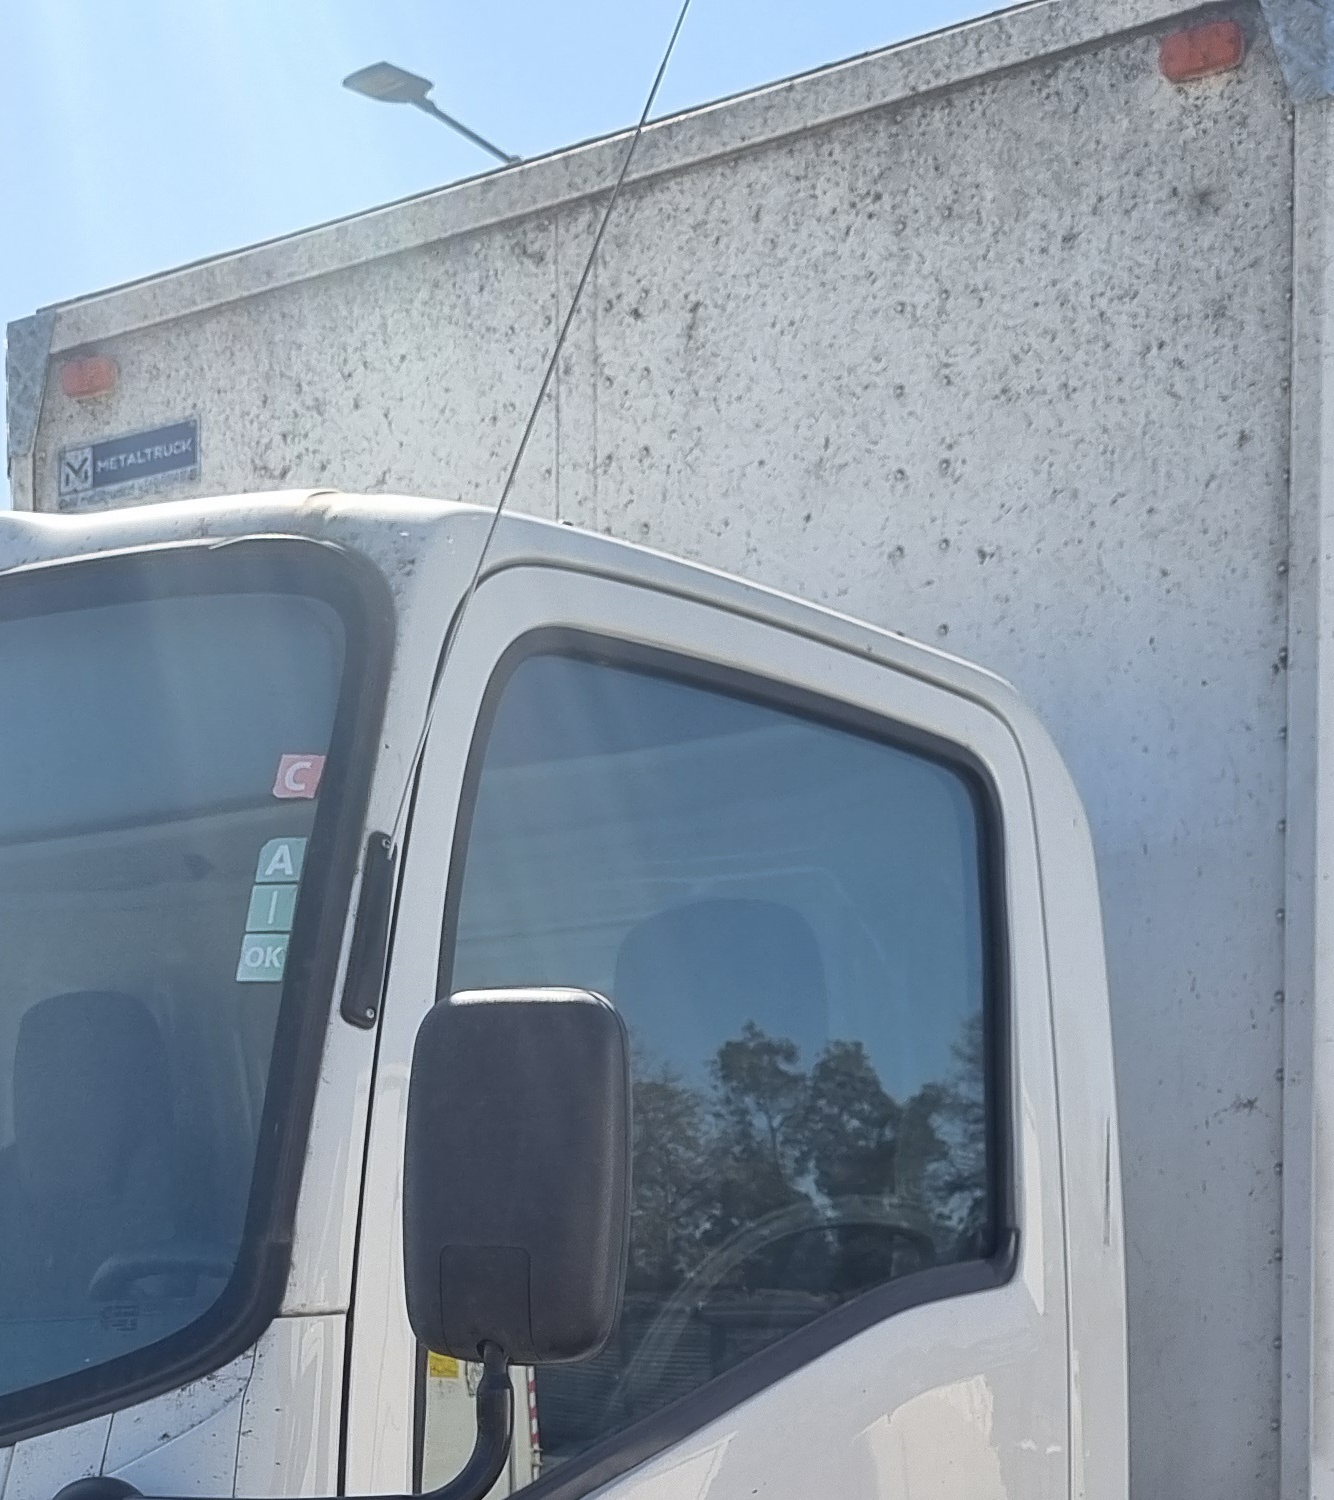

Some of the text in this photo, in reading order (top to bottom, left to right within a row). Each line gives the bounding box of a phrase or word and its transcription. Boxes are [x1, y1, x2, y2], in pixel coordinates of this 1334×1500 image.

[95, 437, 194, 474] METALTRUCK
[283, 760, 313, 791] C
[264, 843, 294, 876] A
[245, 945, 285, 969] OK
